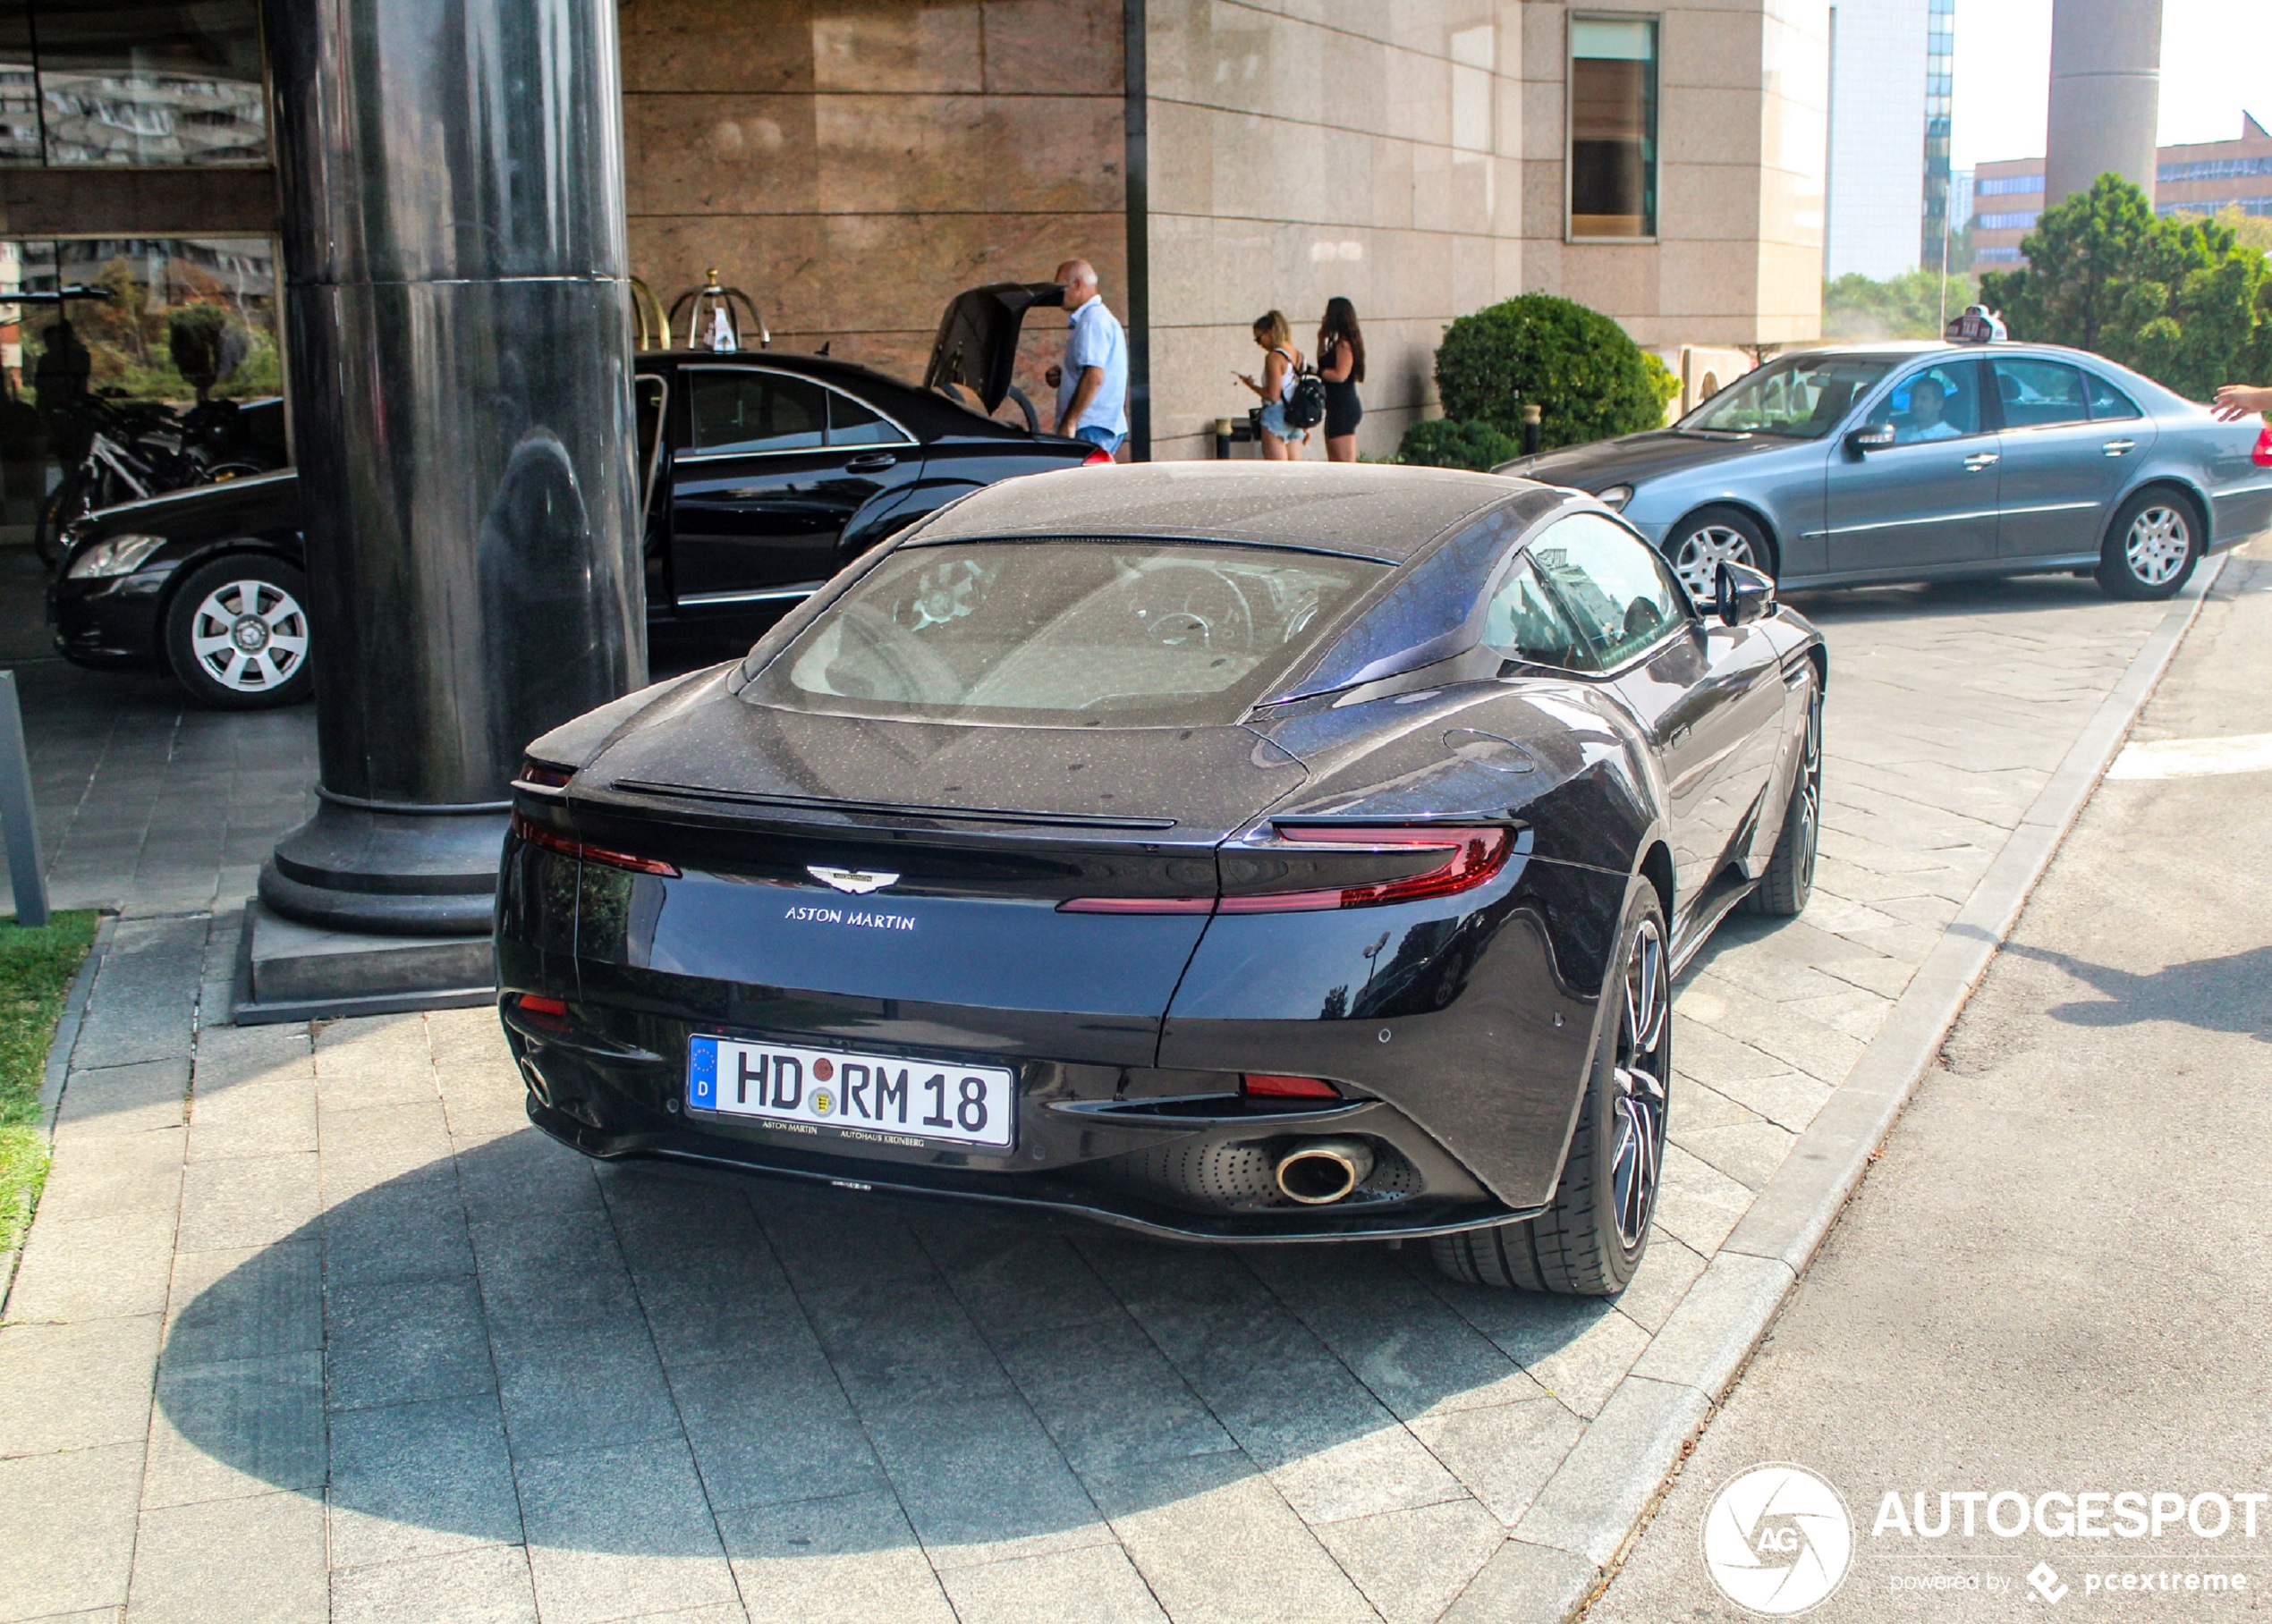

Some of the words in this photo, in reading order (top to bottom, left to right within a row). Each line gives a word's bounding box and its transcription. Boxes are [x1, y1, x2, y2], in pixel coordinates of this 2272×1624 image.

[784, 906, 842, 925] ASTON
[846, 911, 916, 931] MARTIN
[698, 1080, 708, 1096] D
[737, 1051, 803, 1110] HD
[840, 1062, 909, 1124] RM
[922, 1073, 988, 1132] 18
[762, 1121, 787, 1129] ASTON
[788, 1123, 818, 1135] MARTIN
[840, 1130, 883, 1142] AUTOHAUS
[884, 1135, 924, 1147] KRONBERG
